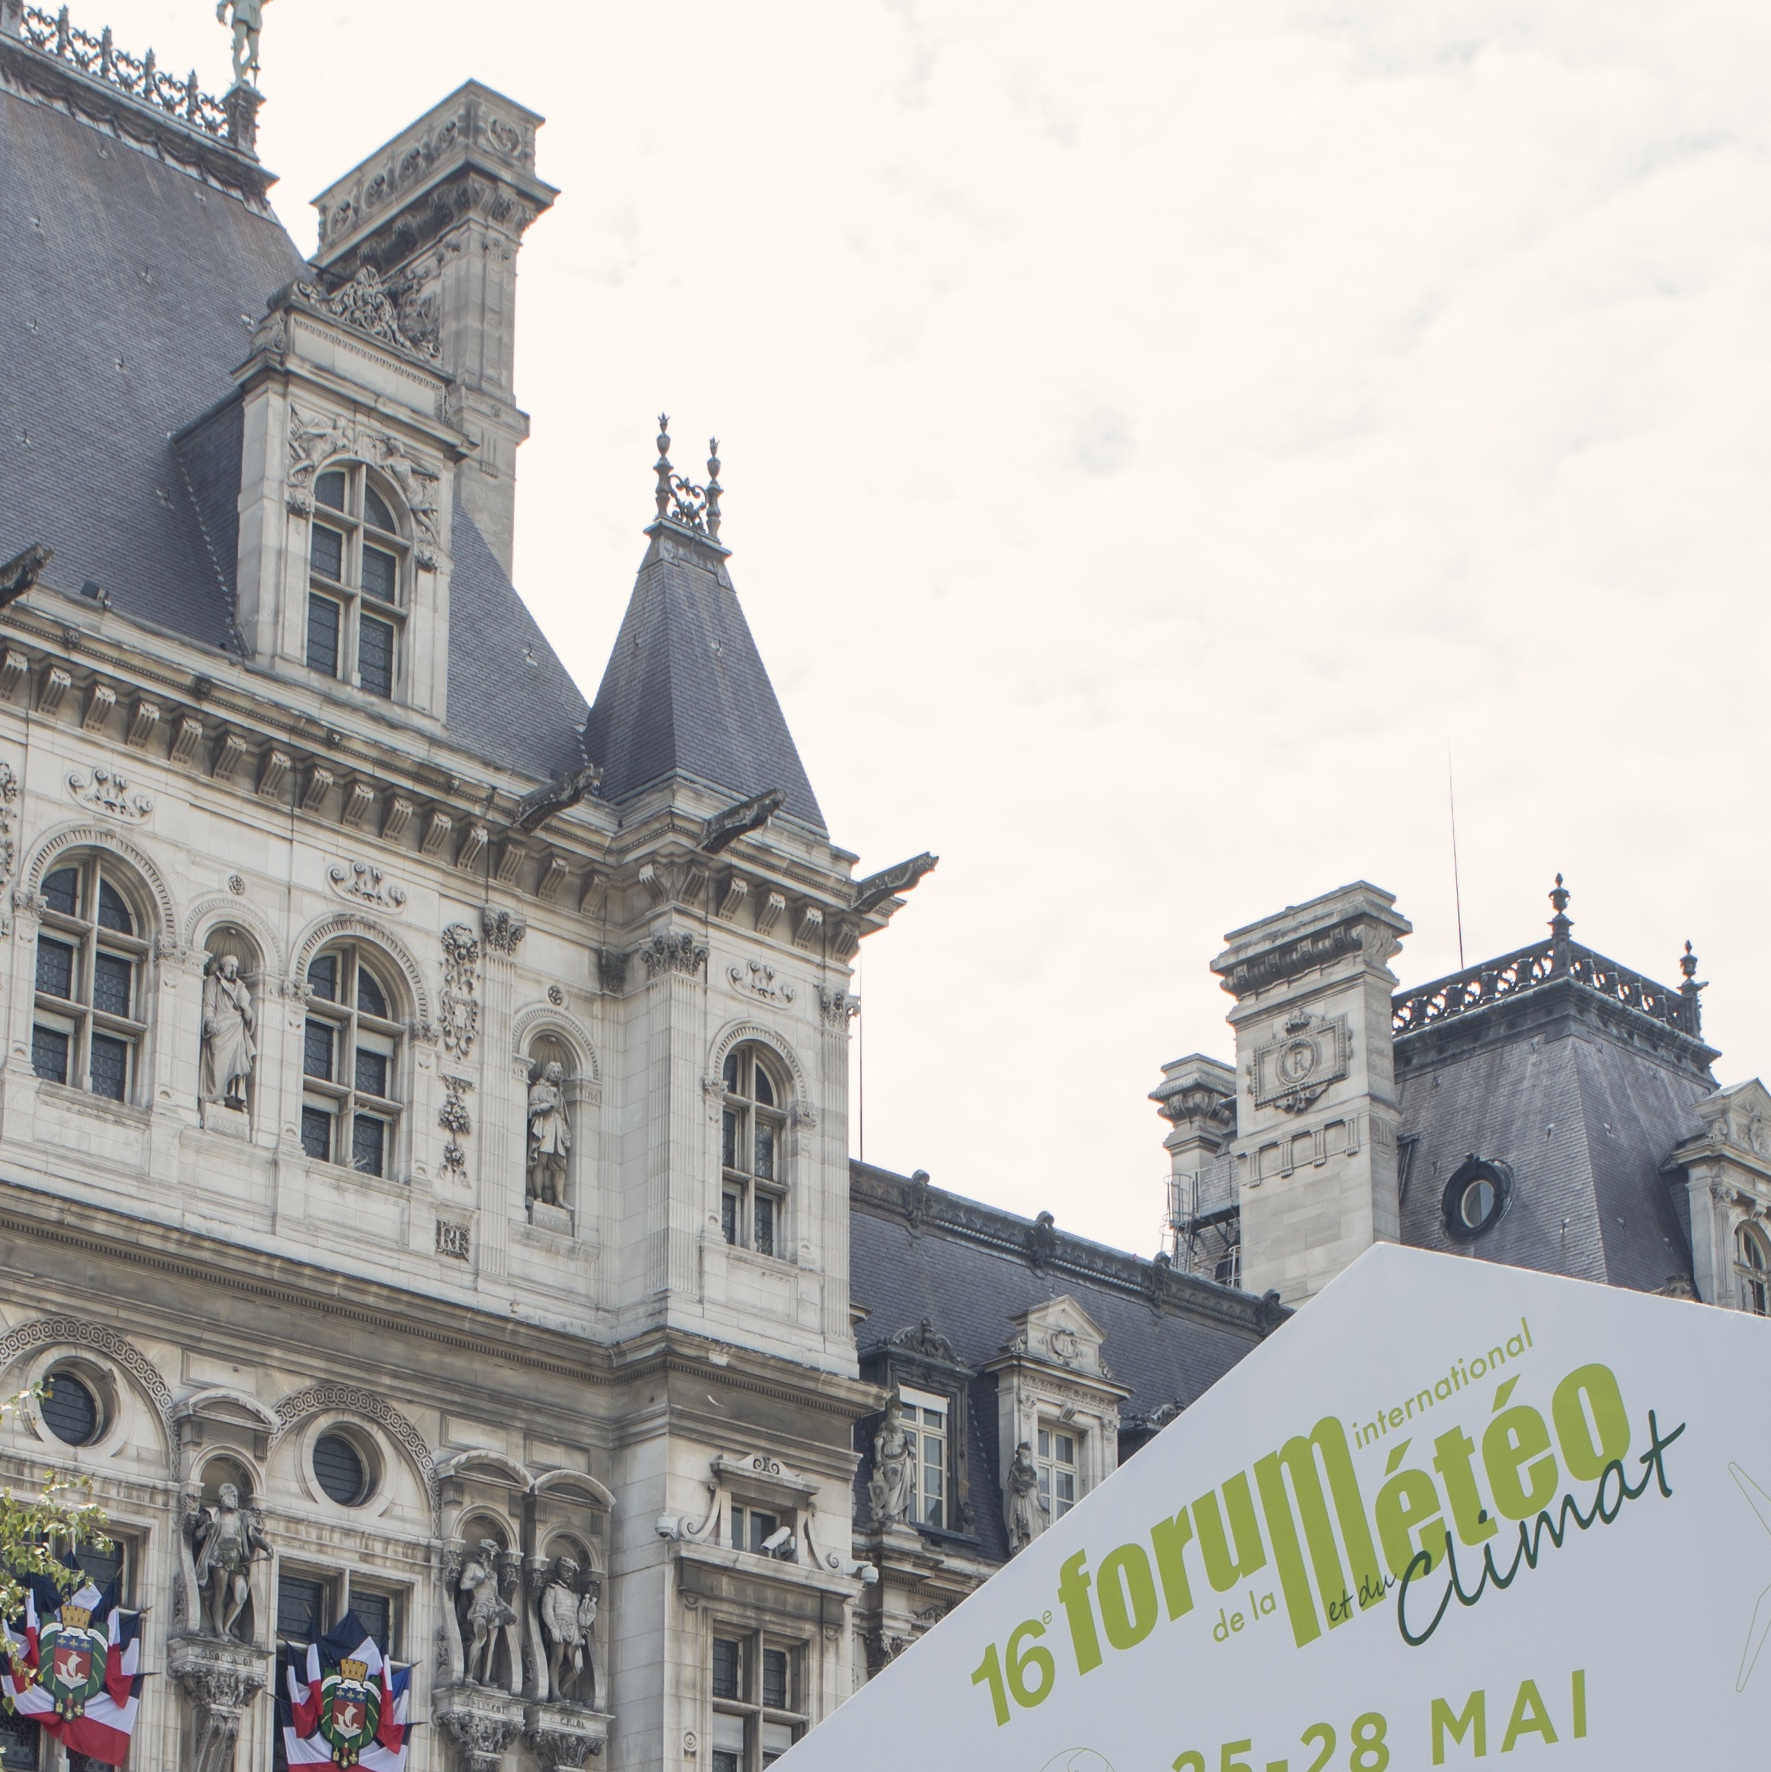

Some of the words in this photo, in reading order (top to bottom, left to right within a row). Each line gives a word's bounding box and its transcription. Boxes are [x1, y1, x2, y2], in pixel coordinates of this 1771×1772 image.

[1352, 1317, 1534, 1449] international
[1213, 1608, 1245, 1642] de
[1249, 1590, 1277, 1621] la
[1329, 1588, 1354, 1622] et
[1359, 1572, 1396, 1607] du
[1431, 1669, 1587, 1766] MAI
